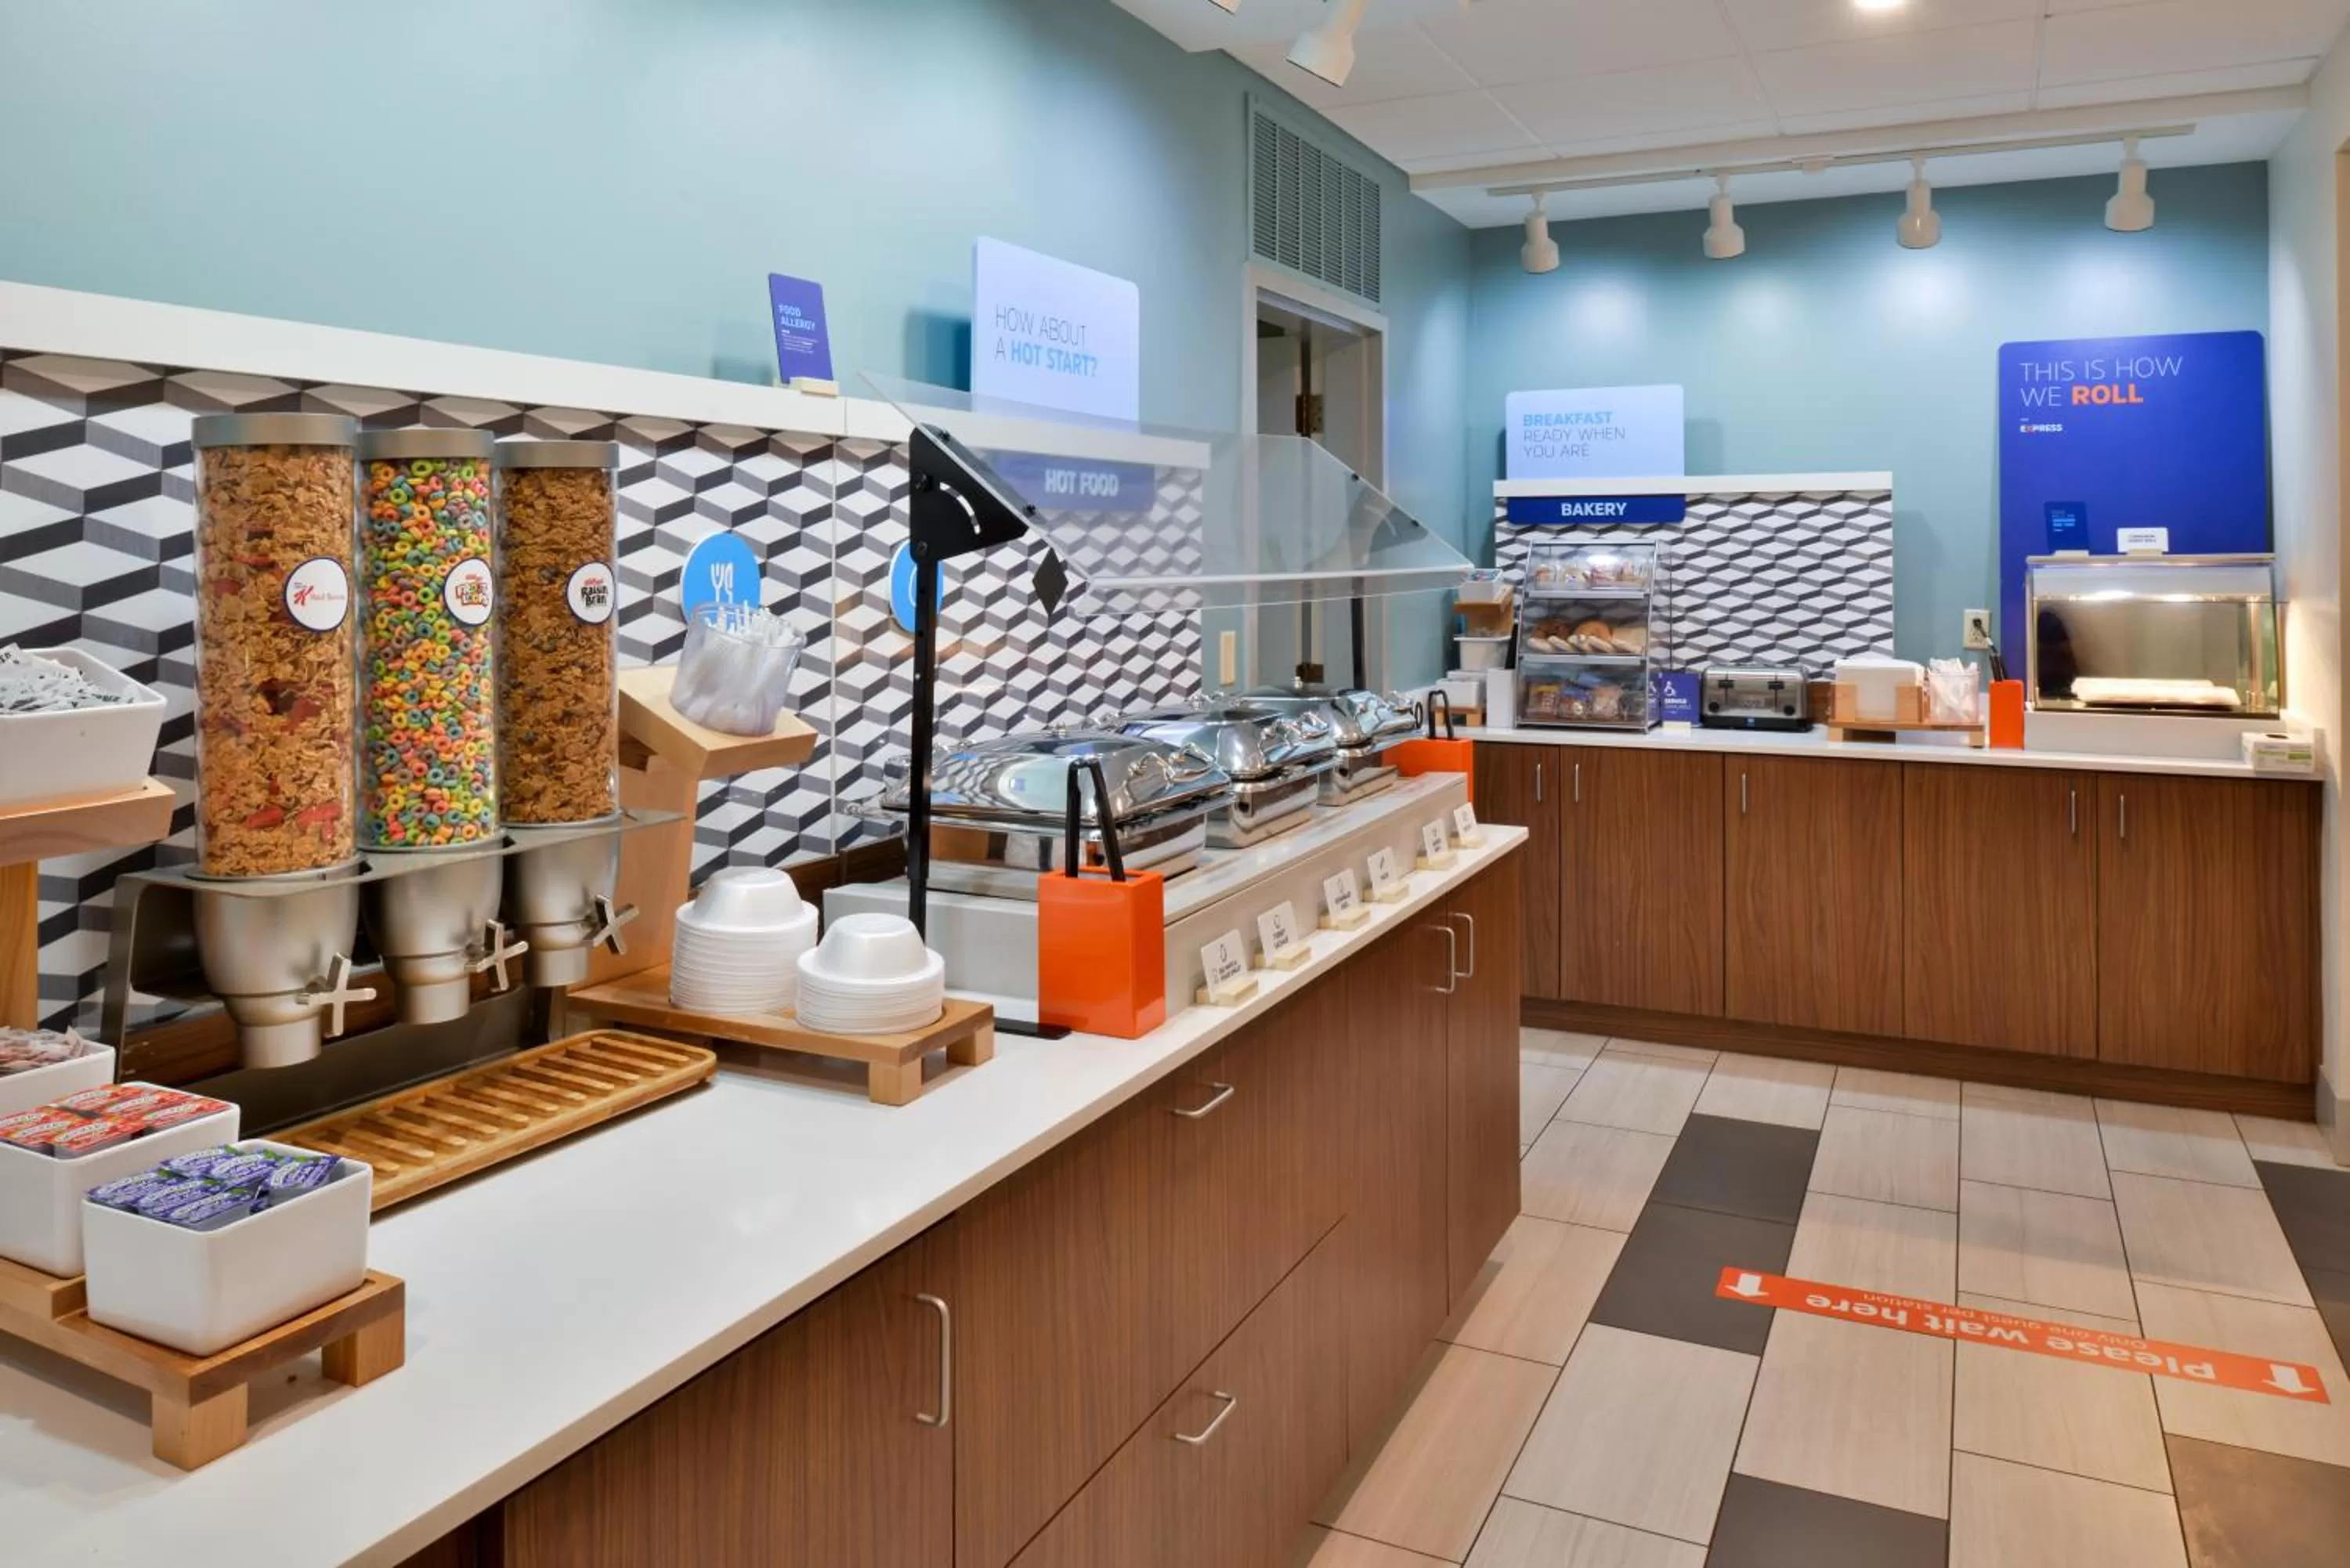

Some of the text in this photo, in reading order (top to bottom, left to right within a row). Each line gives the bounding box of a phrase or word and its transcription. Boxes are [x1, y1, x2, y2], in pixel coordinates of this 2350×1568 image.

[995, 304, 1087, 347] HOW ABOUT
[994, 337, 1098, 378] A HOT START?
[2019, 356, 2183, 382] THIS IS HOW
[2020, 382, 2145, 407] WE ROLL
[1523, 411, 1614, 427] BREAKFAST
[1523, 426, 1627, 443] READY WHEN
[1523, 443, 1590, 458] YOU ARE
[1044, 468, 1120, 497] HOT FOOD
[1560, 501, 1628, 517] BAKERY
[1863, 1293, 2148, 1349] Only one guest per station
[1805, 1294, 2216, 1379] Please wait here
